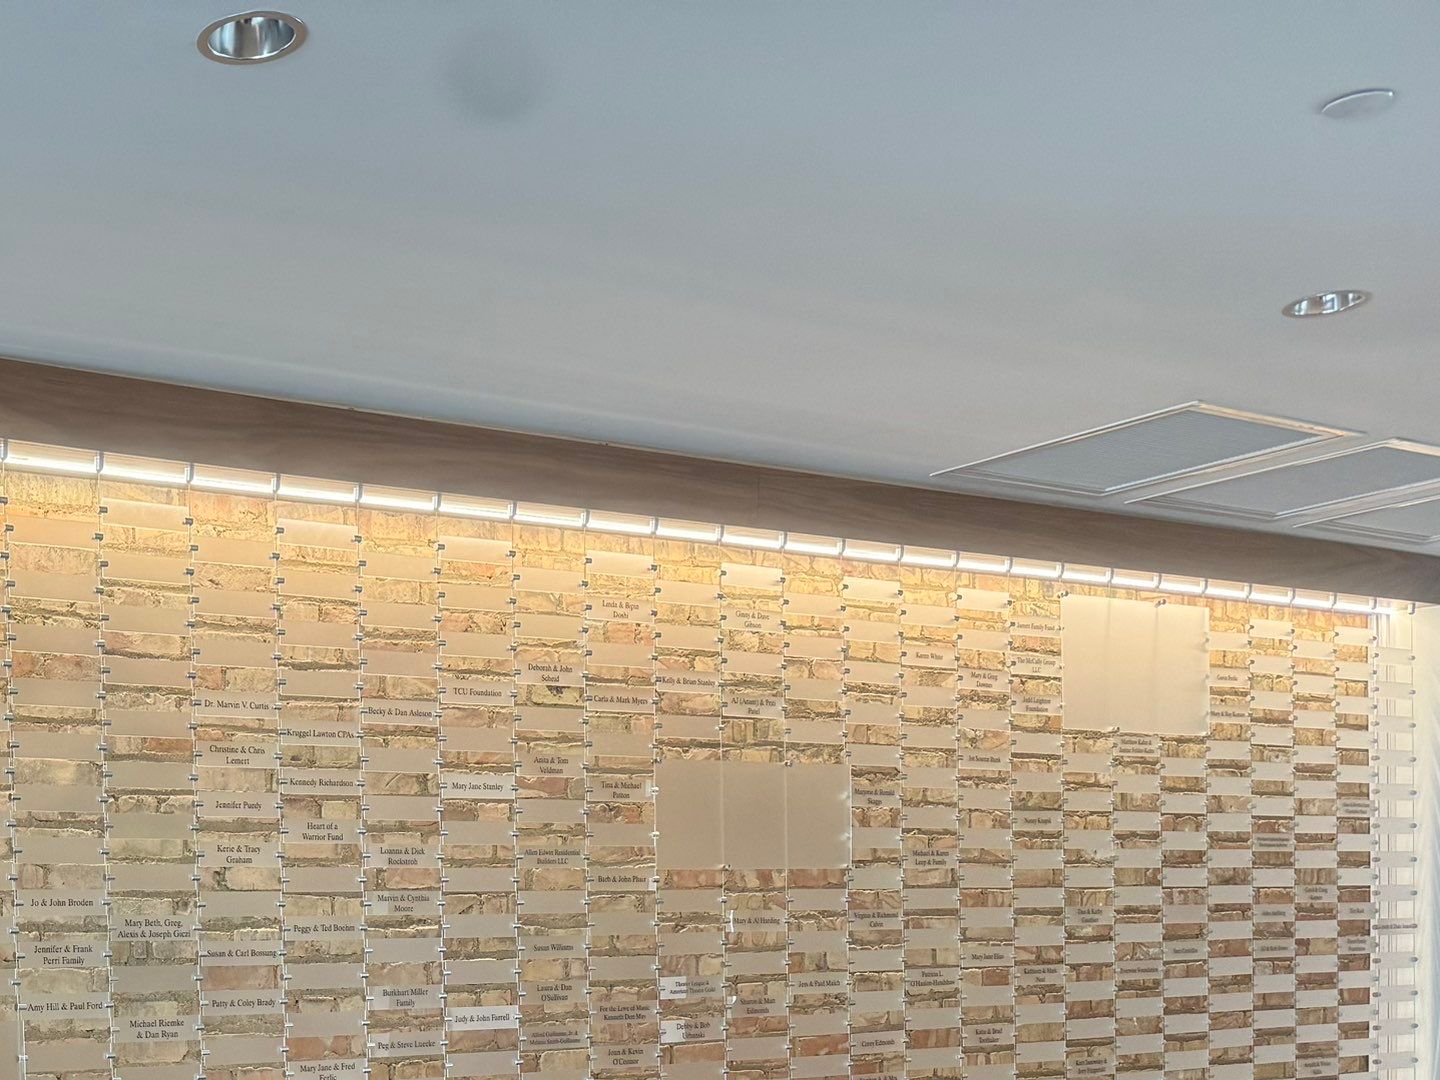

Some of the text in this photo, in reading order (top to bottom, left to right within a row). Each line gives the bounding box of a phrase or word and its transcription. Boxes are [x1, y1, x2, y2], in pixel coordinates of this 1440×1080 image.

[452, 782, 467, 791] Mary
[483, 783, 504, 792] Stanley
[30, 899, 39, 907] Jo
[41, 899, 47, 907] &
[49, 899, 66, 907] John
[125, 919, 142, 928] Mary
[140, 930, 146, 938] &
[148, 930, 172, 939] Joseph
[34, 944, 93, 953] Jennifer & Frank
[62, 956, 85, 966] Family
[27, 1002, 43, 1012] Amy
[44, 1002, 59, 1011] Hill
[70, 1002, 84, 1010] Paul
[86, 1002, 103, 1010] Ford
[212, 1000, 227, 1009] Patty
[257, 998, 275, 1007] Brady
[130, 1020, 157, 1028] Michael
[136, 1031, 143, 1039] &
[161, 1030, 178, 1039] Ryan
[300, 1065, 315, 1073] Mary
